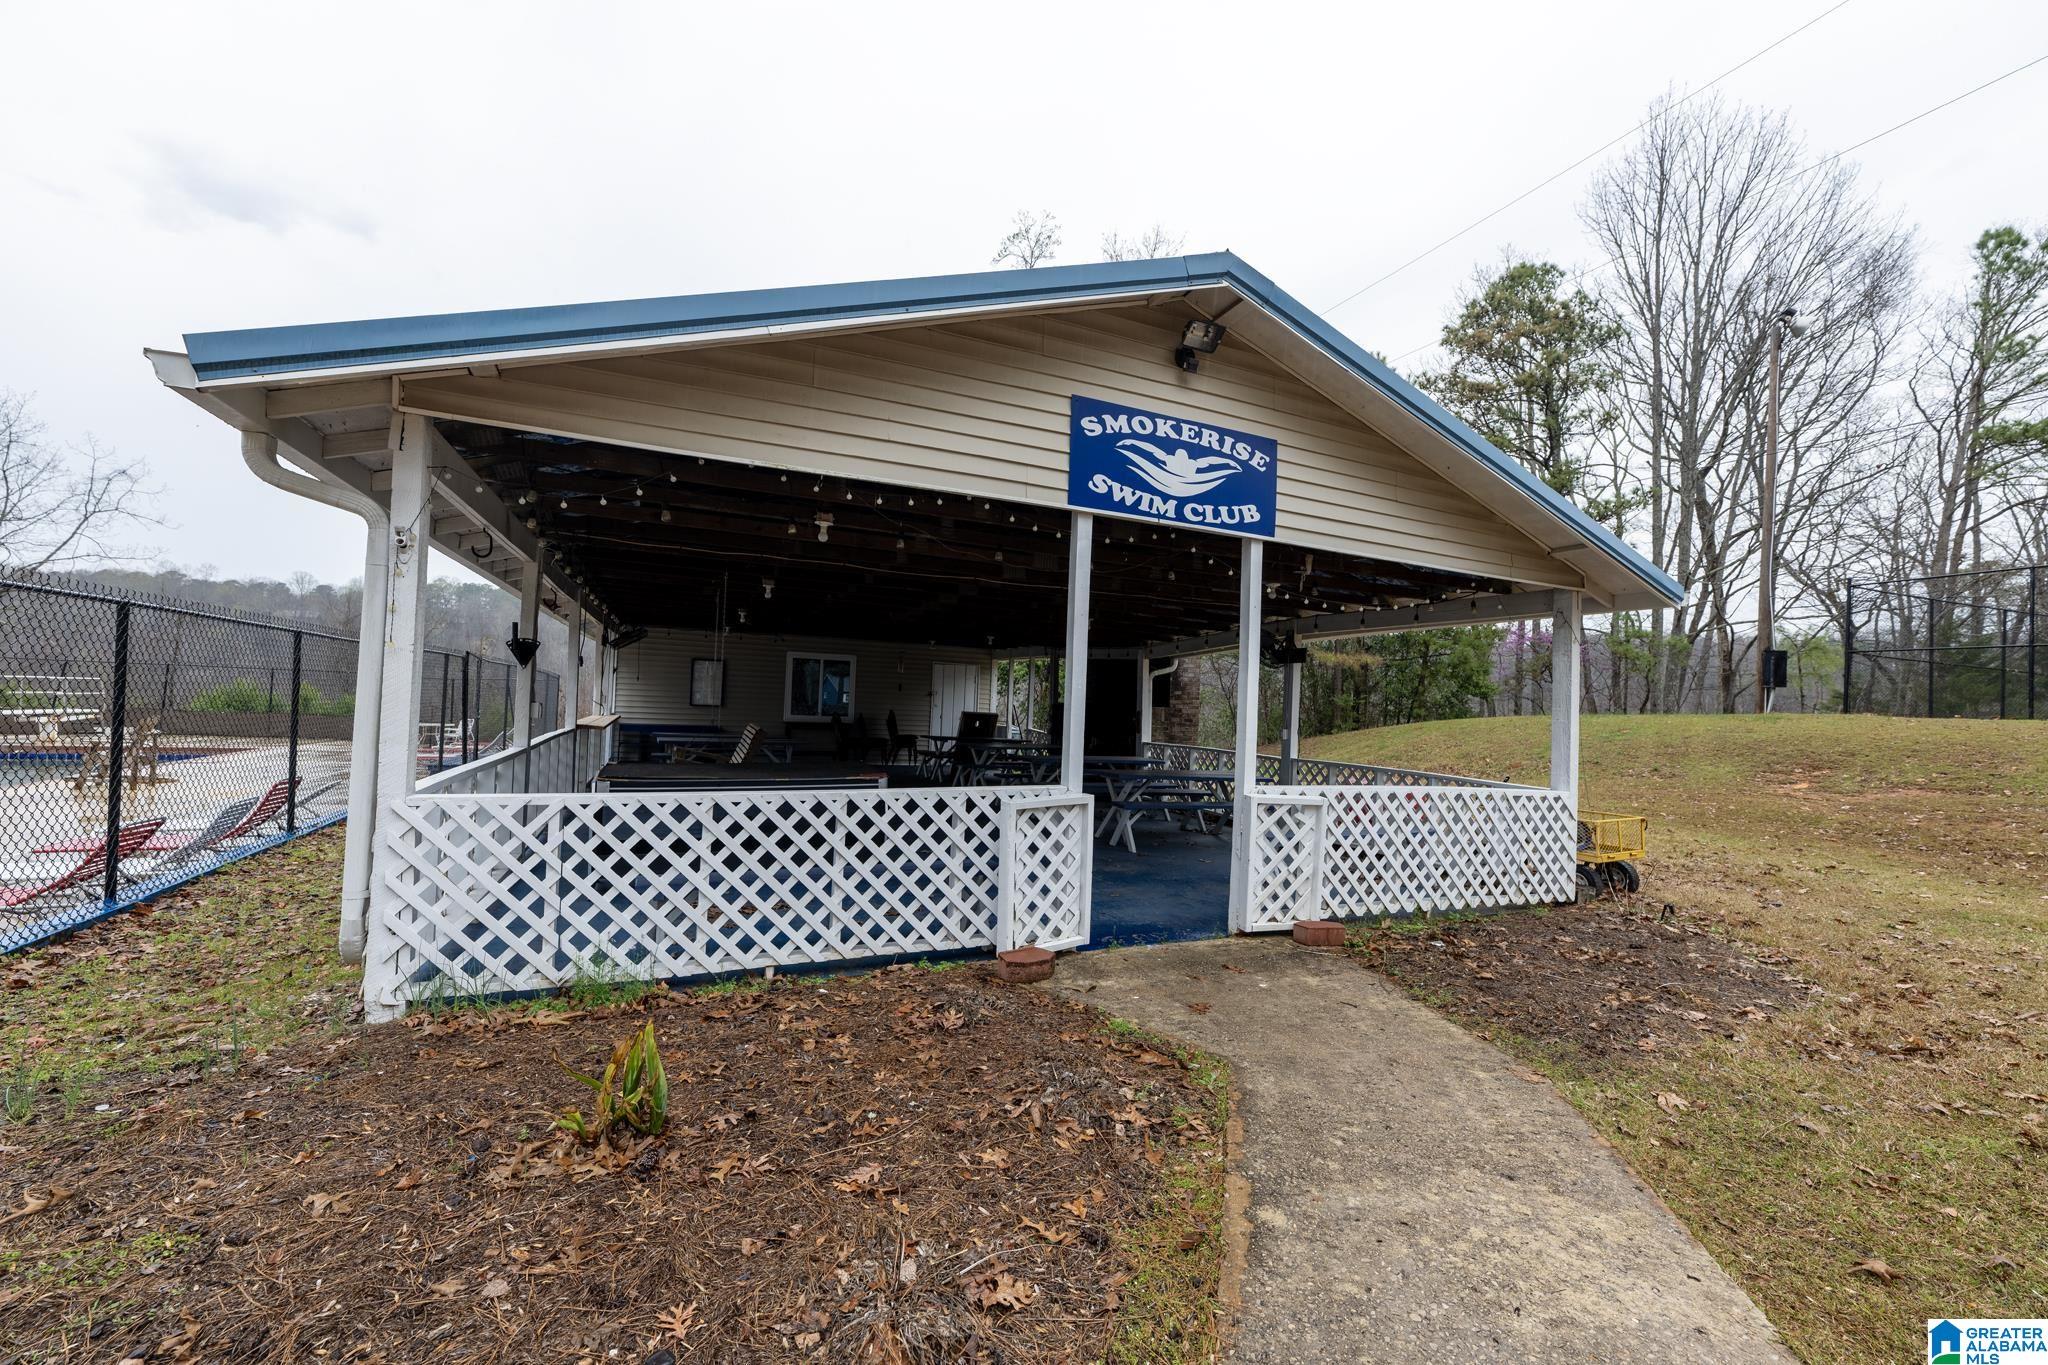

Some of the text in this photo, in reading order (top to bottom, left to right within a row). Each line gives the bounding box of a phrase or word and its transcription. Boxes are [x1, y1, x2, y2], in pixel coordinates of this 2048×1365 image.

[1080, 414, 1270, 472] SMOKERISE
[1088, 473, 1261, 524] SWIM CLUB
